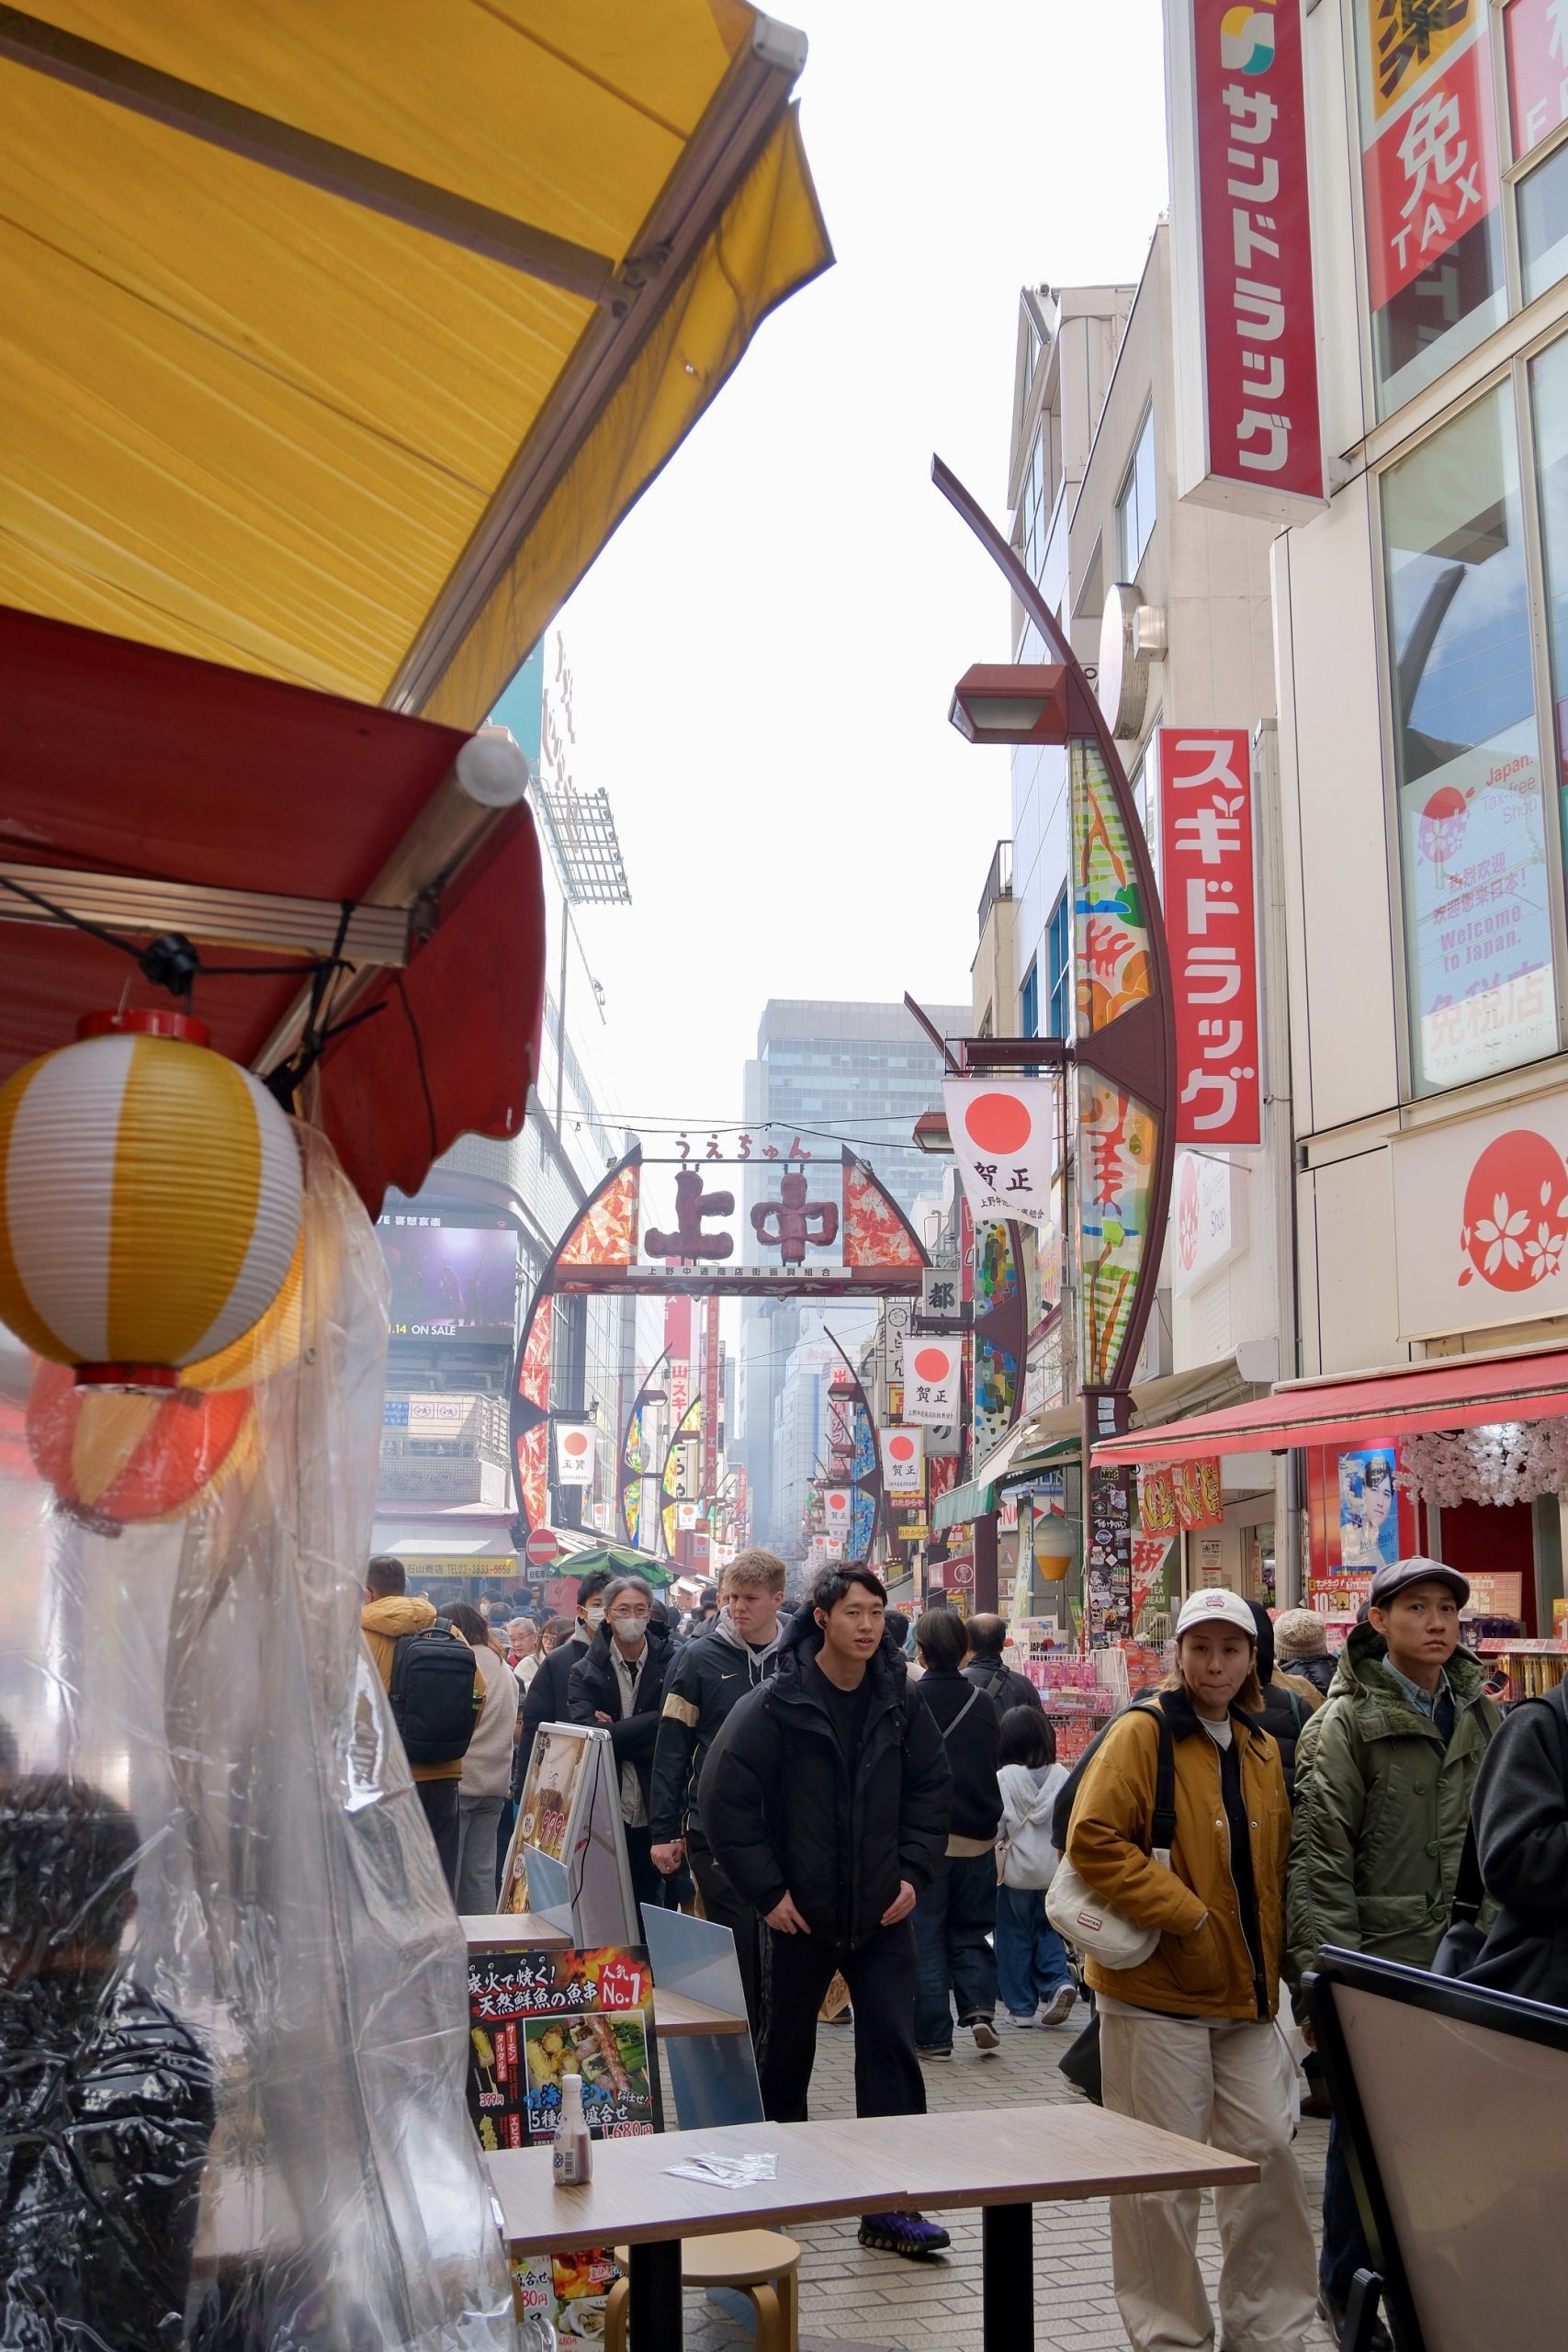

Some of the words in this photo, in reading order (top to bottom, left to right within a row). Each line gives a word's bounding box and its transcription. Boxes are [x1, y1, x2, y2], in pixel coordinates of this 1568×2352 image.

[1396, 92, 1468, 220] 免
[1391, 161, 1483, 271] TAX
[1221, 82, 1292, 472] サンドラッグ
[1485, 752, 1535, 786] Japan.
[1480, 775, 1537, 813] Tax-free
[1503, 797, 1539, 825] Shop
[1173, 739, 1255, 1131] スギドラッグ
[1440, 904, 1523, 954] Welcome
[1443, 953, 1461, 974] to
[1465, 929, 1523, 966] Japan.
[1427, 960, 1546, 1054] 免税店
[1506, 1022, 1545, 1052] SHOP
[675, 1133, 813, 1159] うえちゅん
[974, 1161, 1033, 1193] 賀正
[395, 1216, 441, 1227] 喜怒哀楽
[644, 1170, 840, 1262] 上中
[648, 1267, 831, 1277] 上野中通商店街振興組合
[411, 1324, 429, 1335] ON
[431, 1326, 457, 1336] SALE
[916, 1385, 949, 1404] 賀正
[892, 1464, 917, 1476] 賀正
[406, 1565, 444, 1575] 石山商店
[1132, 1540, 1166, 1573] 税
[1080, 1917, 1100, 1928] HUNTER
[468, 1965, 557, 1996] 炭火で焼く!
[602, 1964, 629, 1981] 人気
[478, 1980, 599, 2018] 天然鮮魚の魚串
[603, 1973, 641, 2006] No.1
[496, 2033, 506, 2080] タルタル串
[506, 2024, 516, 2062] サーモン
[479, 2092, 504, 2107] 399円
[511, 2116, 520, 2147] エビマ
